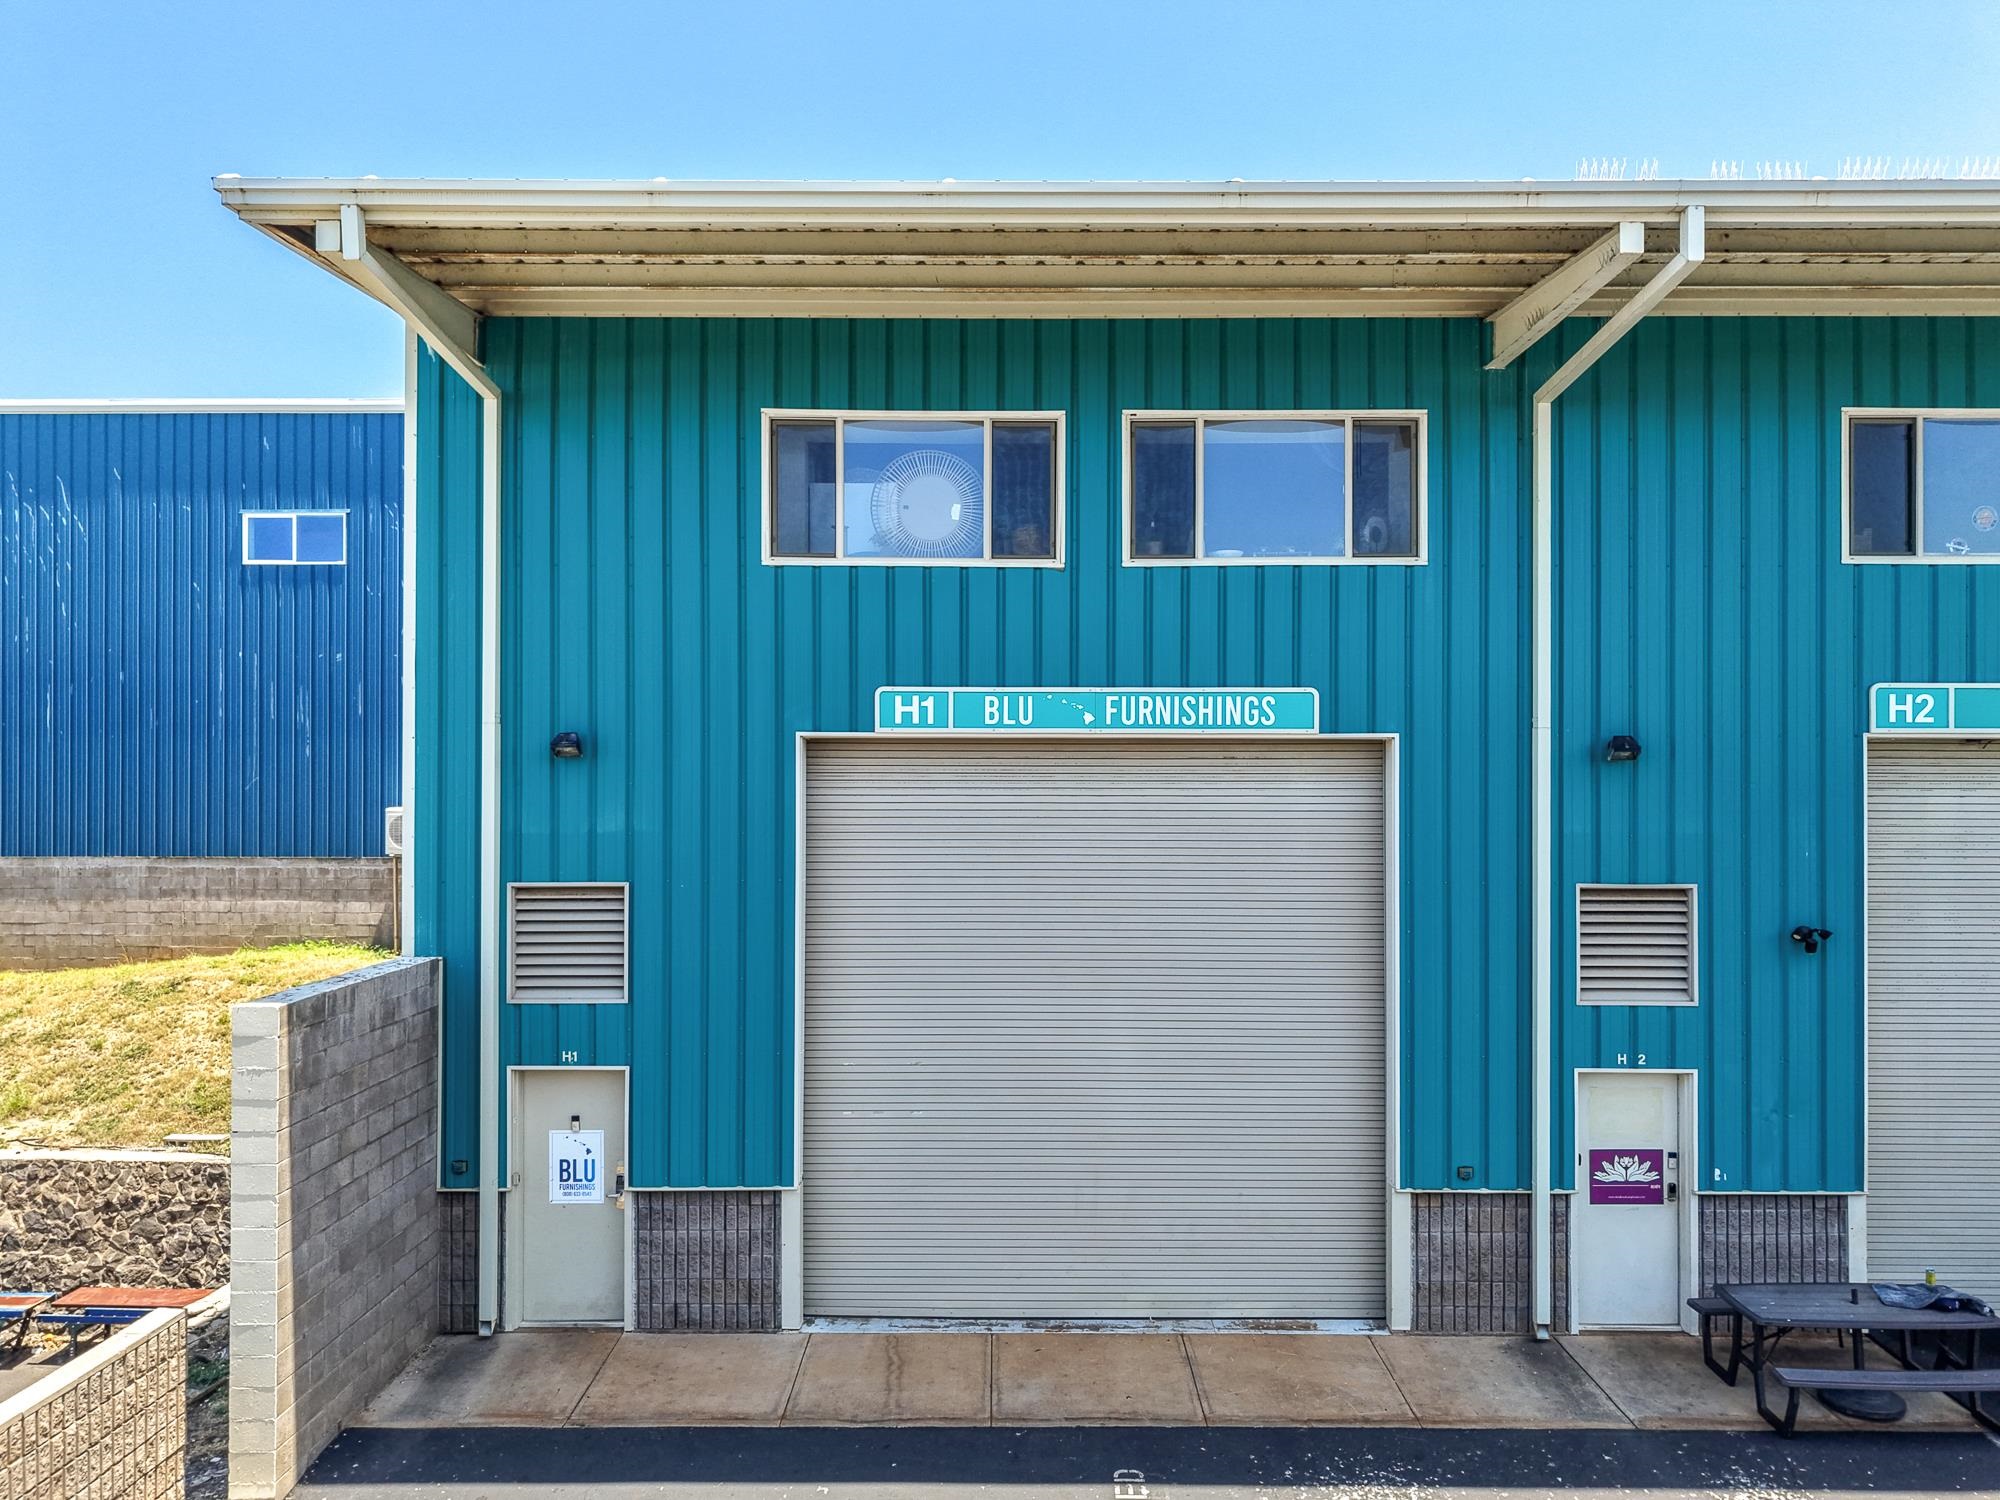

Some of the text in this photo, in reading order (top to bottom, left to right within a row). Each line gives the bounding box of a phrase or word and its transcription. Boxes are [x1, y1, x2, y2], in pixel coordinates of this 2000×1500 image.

[894, 695, 936, 725] H1
[984, 695, 1277, 726] BLU FURNISHINGS
[1888, 693, 1935, 723] H2
[562, 1050, 578, 1063] H1
[559, 1158, 596, 1183] BLU
[559, 1183, 596, 1191] FURNISHINGS
